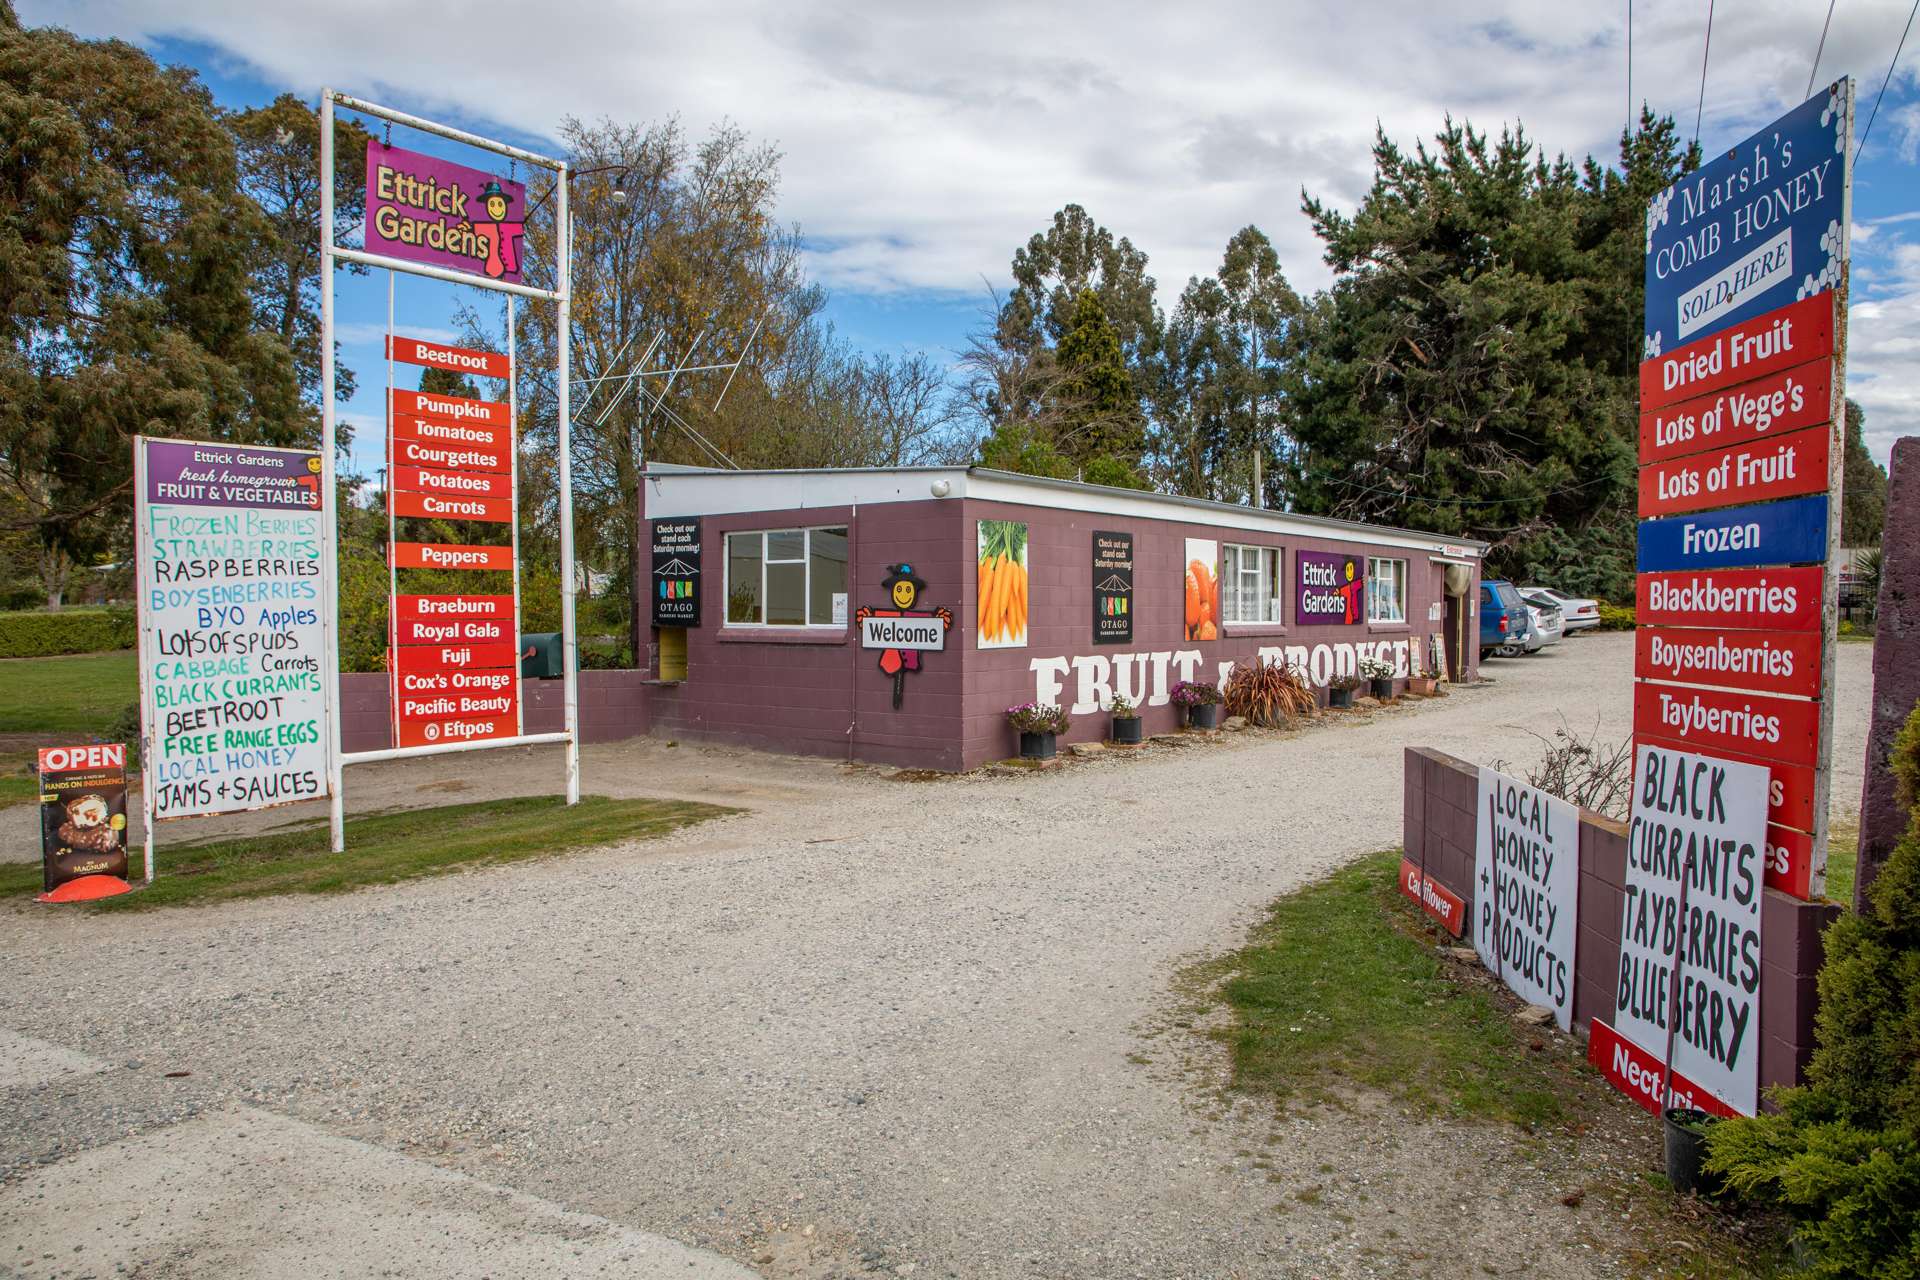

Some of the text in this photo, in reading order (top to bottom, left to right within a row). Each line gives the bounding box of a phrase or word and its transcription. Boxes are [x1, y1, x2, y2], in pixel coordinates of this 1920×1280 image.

[377, 165, 468, 218] Ettrick
[1680, 132, 1792, 226] Marsh's
[1656, 158, 1832, 280] COMB HONEY
[375, 206, 489, 259] Gardens
[1682, 241, 1788, 325] SOLD HERE
[416, 344, 488, 370] Beetroot
[1663, 318, 1793, 391] Dried Fruit
[416, 395, 490, 419] Pumpkin
[1656, 378, 1803, 447] Lots of Vege's
[415, 420, 494, 443] Tomatoes
[194, 451, 284, 468] Ettrick Gardens
[407, 444, 498, 467] Courgettes
[179, 467, 297, 488] fresh homegrown
[419, 471, 491, 491] Potatoes
[1658, 446, 1796, 500] Lots of Fruit
[157, 483, 317, 505] FRUIT & VEGETABLES
[423, 497, 486, 515] Carrots
[150, 506, 316, 538] FROZEN BERRIES
[153, 539, 320, 560] STRAWBERRIES
[1683, 523, 1760, 554] Frozen
[421, 547, 489, 566] Peppers
[155, 559, 319, 583] RASPBERRIES
[1303, 561, 1337, 586] Ettrick
[152, 581, 316, 611] BOYSENBERRIES
[418, 598, 495, 614] Braeburn
[660, 603, 693, 612] OTAGO
[1302, 589, 1345, 613] Gardens
[1649, 578, 1797, 613] Blackberries
[198, 605, 317, 631] BYO Apples
[1101, 620, 1128, 629] OTAGO
[413, 623, 500, 641] Royal Gala
[868, 621, 938, 643] Welcome
[155, 653, 319, 680] CABBAGE Carrots
[442, 648, 470, 666] Fuji
[1651, 636, 1794, 677] Boysenberries
[404, 673, 510, 690] Cox's Orange
[1028, 649, 1203, 715] FRUIT
[166, 697, 283, 737] BEETROOT
[405, 697, 511, 716] Pacific Beauty
[1659, 694, 1780, 743] Tayberries
[164, 720, 319, 758] FREE RANGE EGGS
[444, 721, 494, 739] Eftpos
[46, 745, 123, 770] OPEN
[159, 747, 297, 783] LOCAL HONEY
[158, 779, 211, 811] JAMS
[233, 771, 318, 802] SAUCES
[1642, 751, 1726, 824] BLACK
[1496, 780, 1553, 844] LOCAL
[1497, 869, 1557, 943] HONEY
[1617, 951, 1750, 1072] BLUEBERRY
[1612, 1042, 1706, 1112] Nectari
